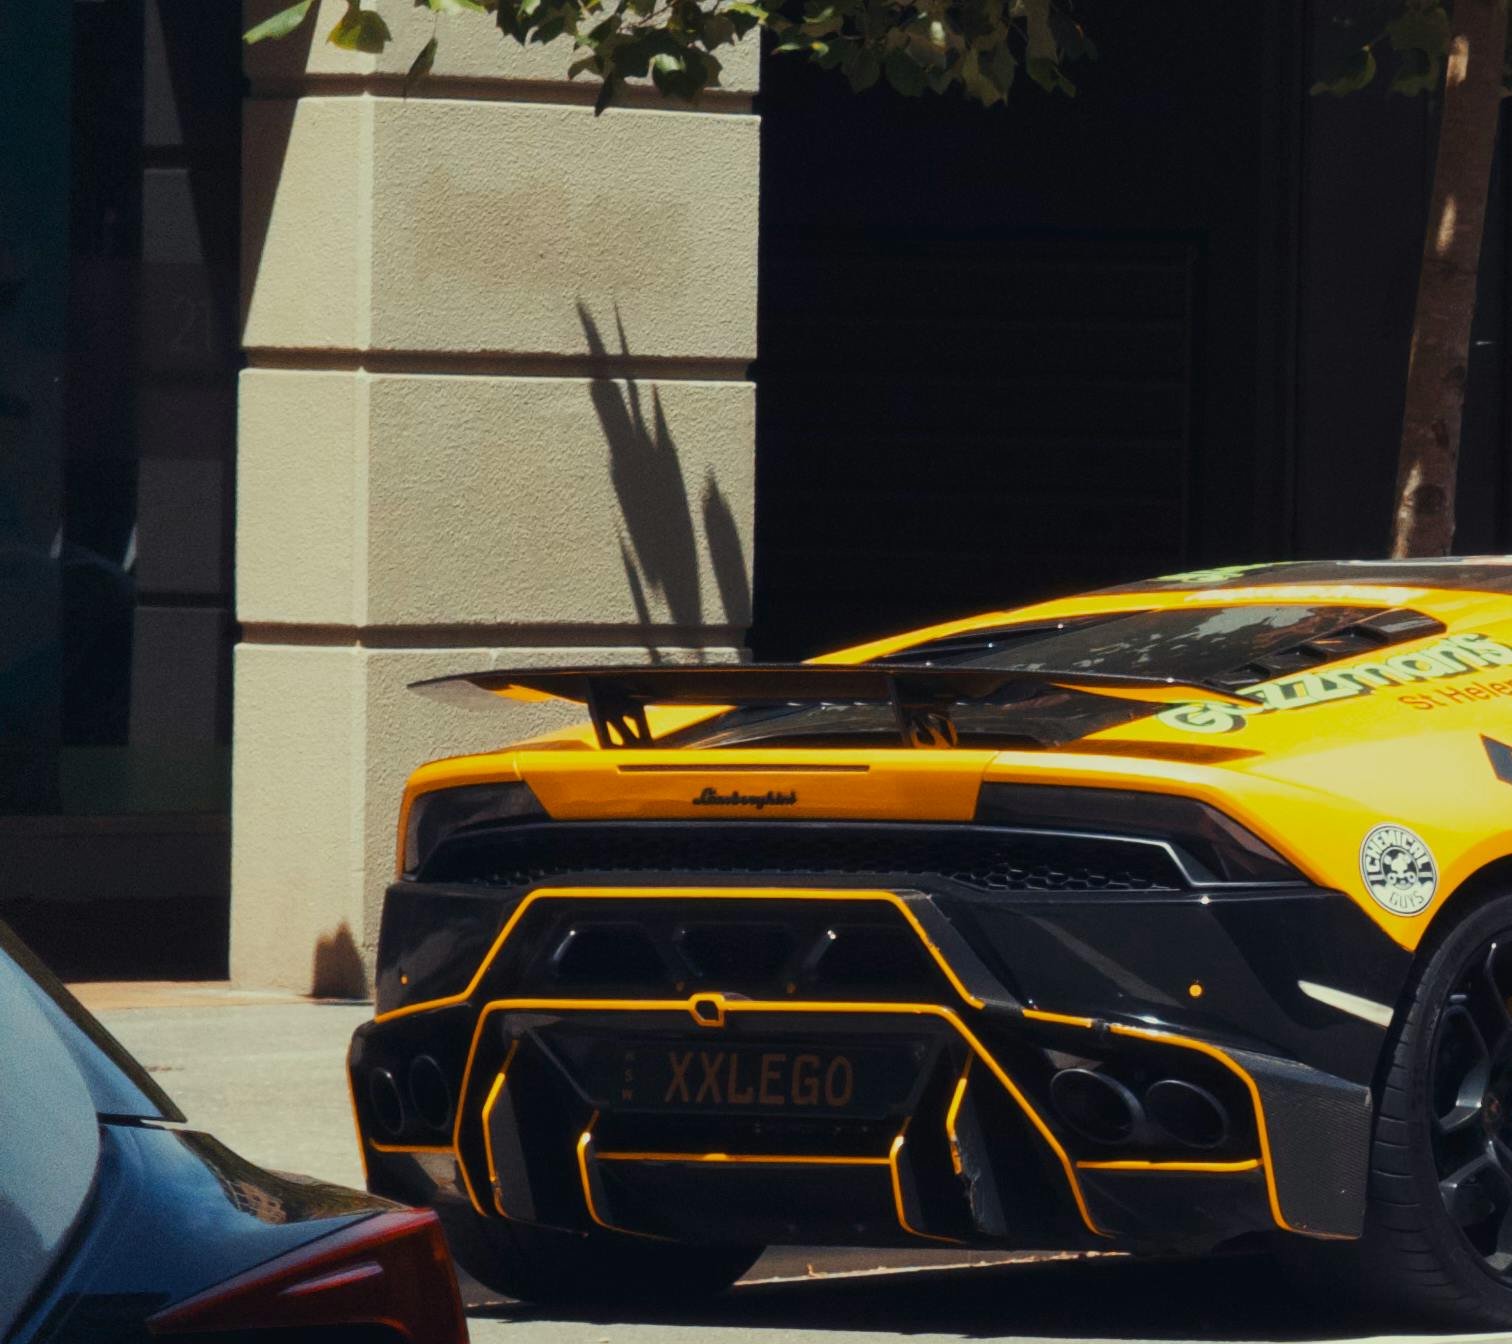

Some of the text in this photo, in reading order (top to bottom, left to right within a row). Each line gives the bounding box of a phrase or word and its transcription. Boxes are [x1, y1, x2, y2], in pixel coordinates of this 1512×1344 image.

[1399, 693, 1448, 711] St
[1365, 828, 1433, 873] CHEMICAL
[1389, 889, 1425, 909] GUYS
